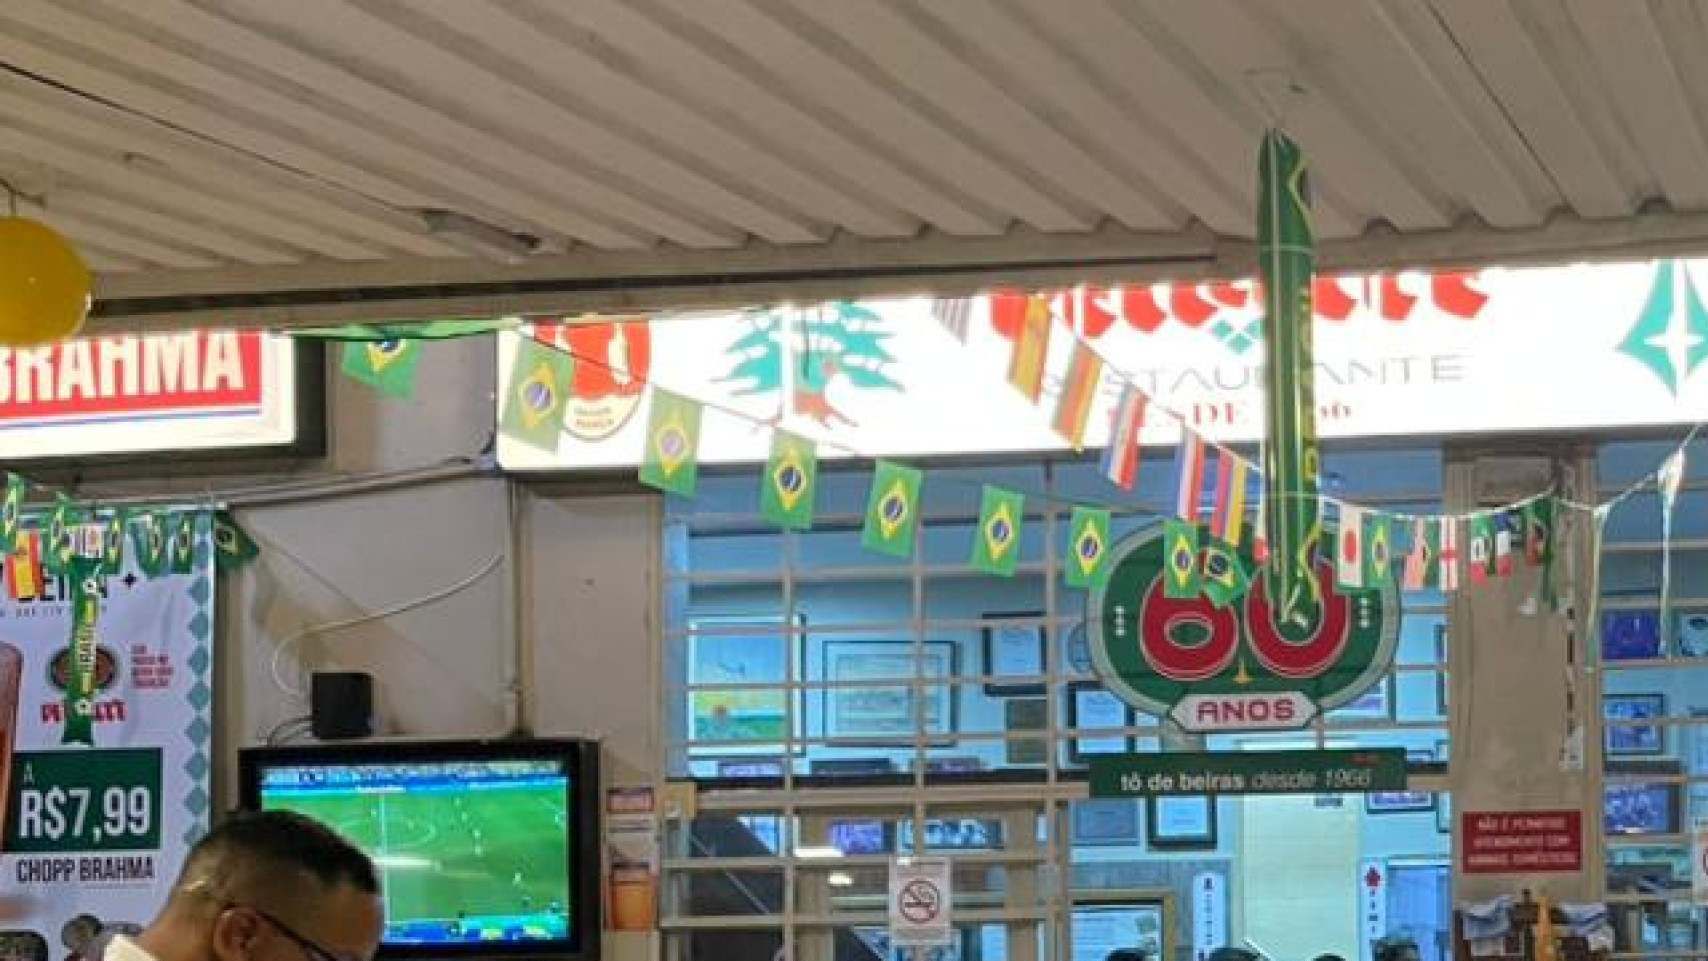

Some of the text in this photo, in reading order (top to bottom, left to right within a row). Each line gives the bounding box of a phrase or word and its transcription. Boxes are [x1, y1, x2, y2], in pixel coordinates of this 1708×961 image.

[1140, 560, 1351, 681] 60
[1196, 699, 1295, 723] ANOS
[1148, 771, 1173, 790] de
[1180, 770, 1245, 790] beiras
[1251, 769, 1317, 789] desde
[19, 786, 151, 843] R$7,99
[16, 855, 155, 882] CHOPP BRAHMA
